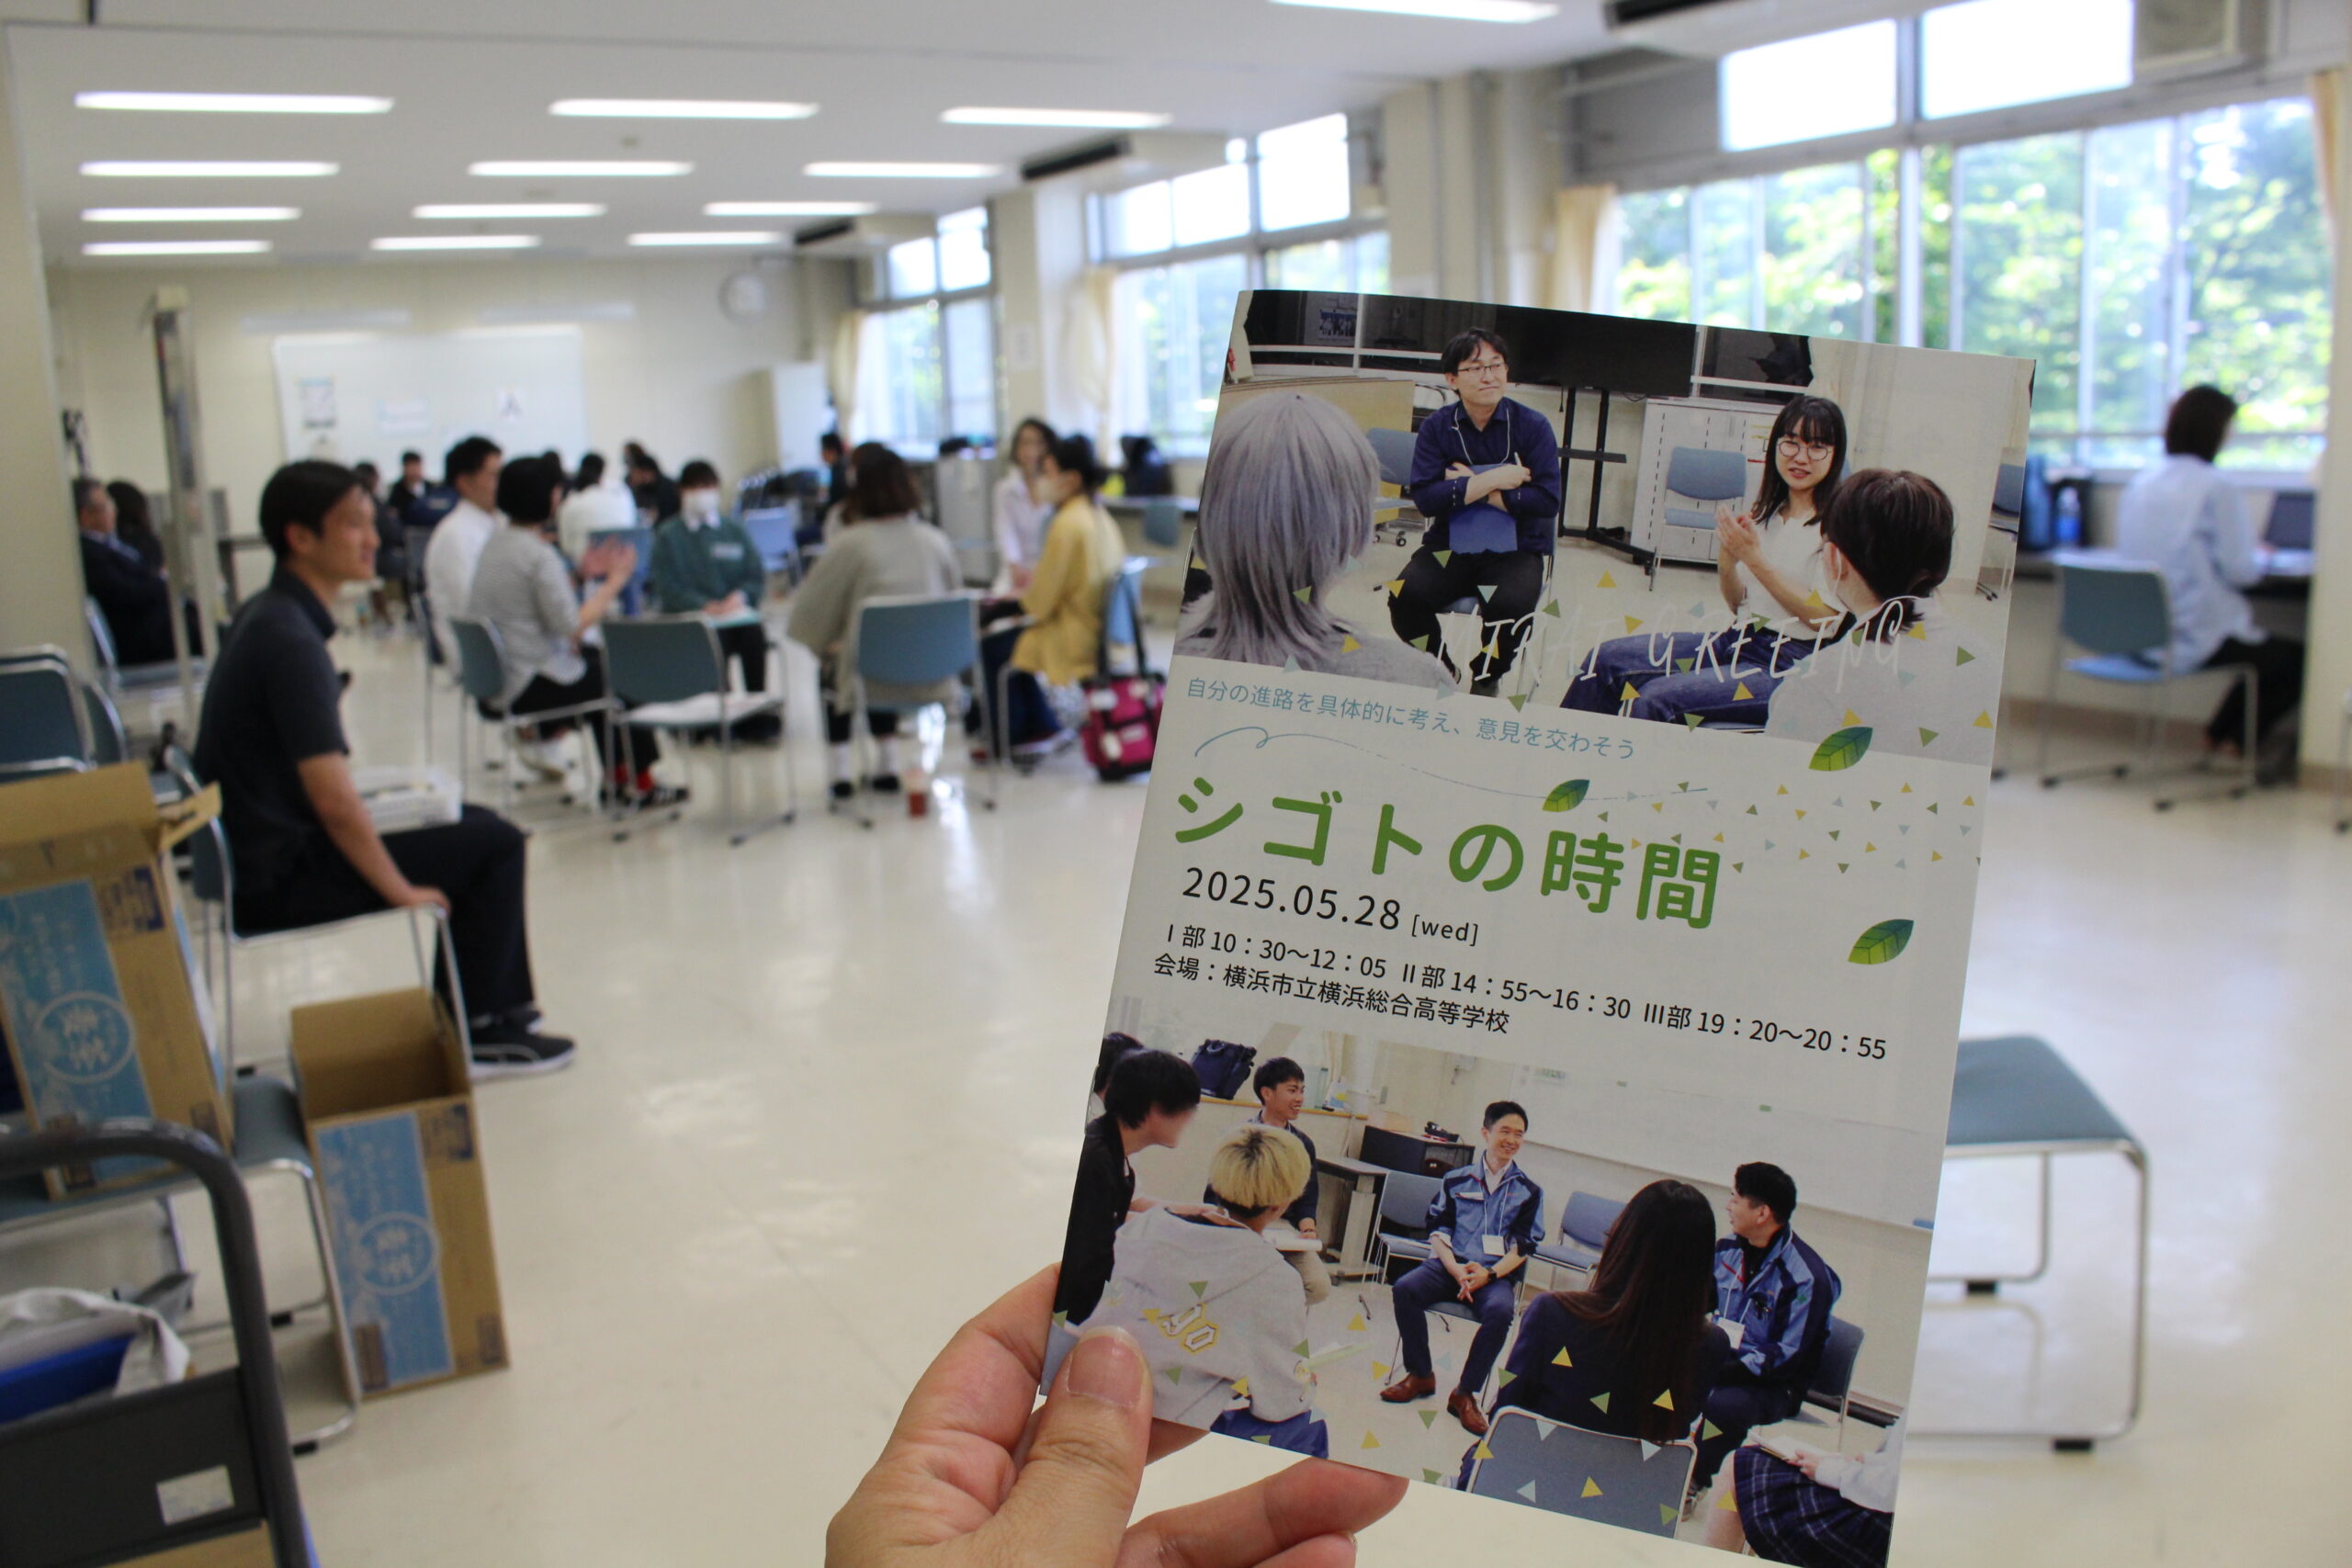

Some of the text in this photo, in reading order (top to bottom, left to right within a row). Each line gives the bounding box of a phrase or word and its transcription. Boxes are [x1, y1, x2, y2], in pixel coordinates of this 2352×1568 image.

[1647, 600, 1905, 694] GREETING
[1187, 678, 1634, 761] 自分の進路を具体的に考え、意見を交わそう
[1175, 777, 1720, 929] シゴトの時間
[1182, 867, 1478, 947] 2025.05.28 [wed]
[1154, 953, 1510, 1034] 会場：横浜市立横浜総合高等学校
